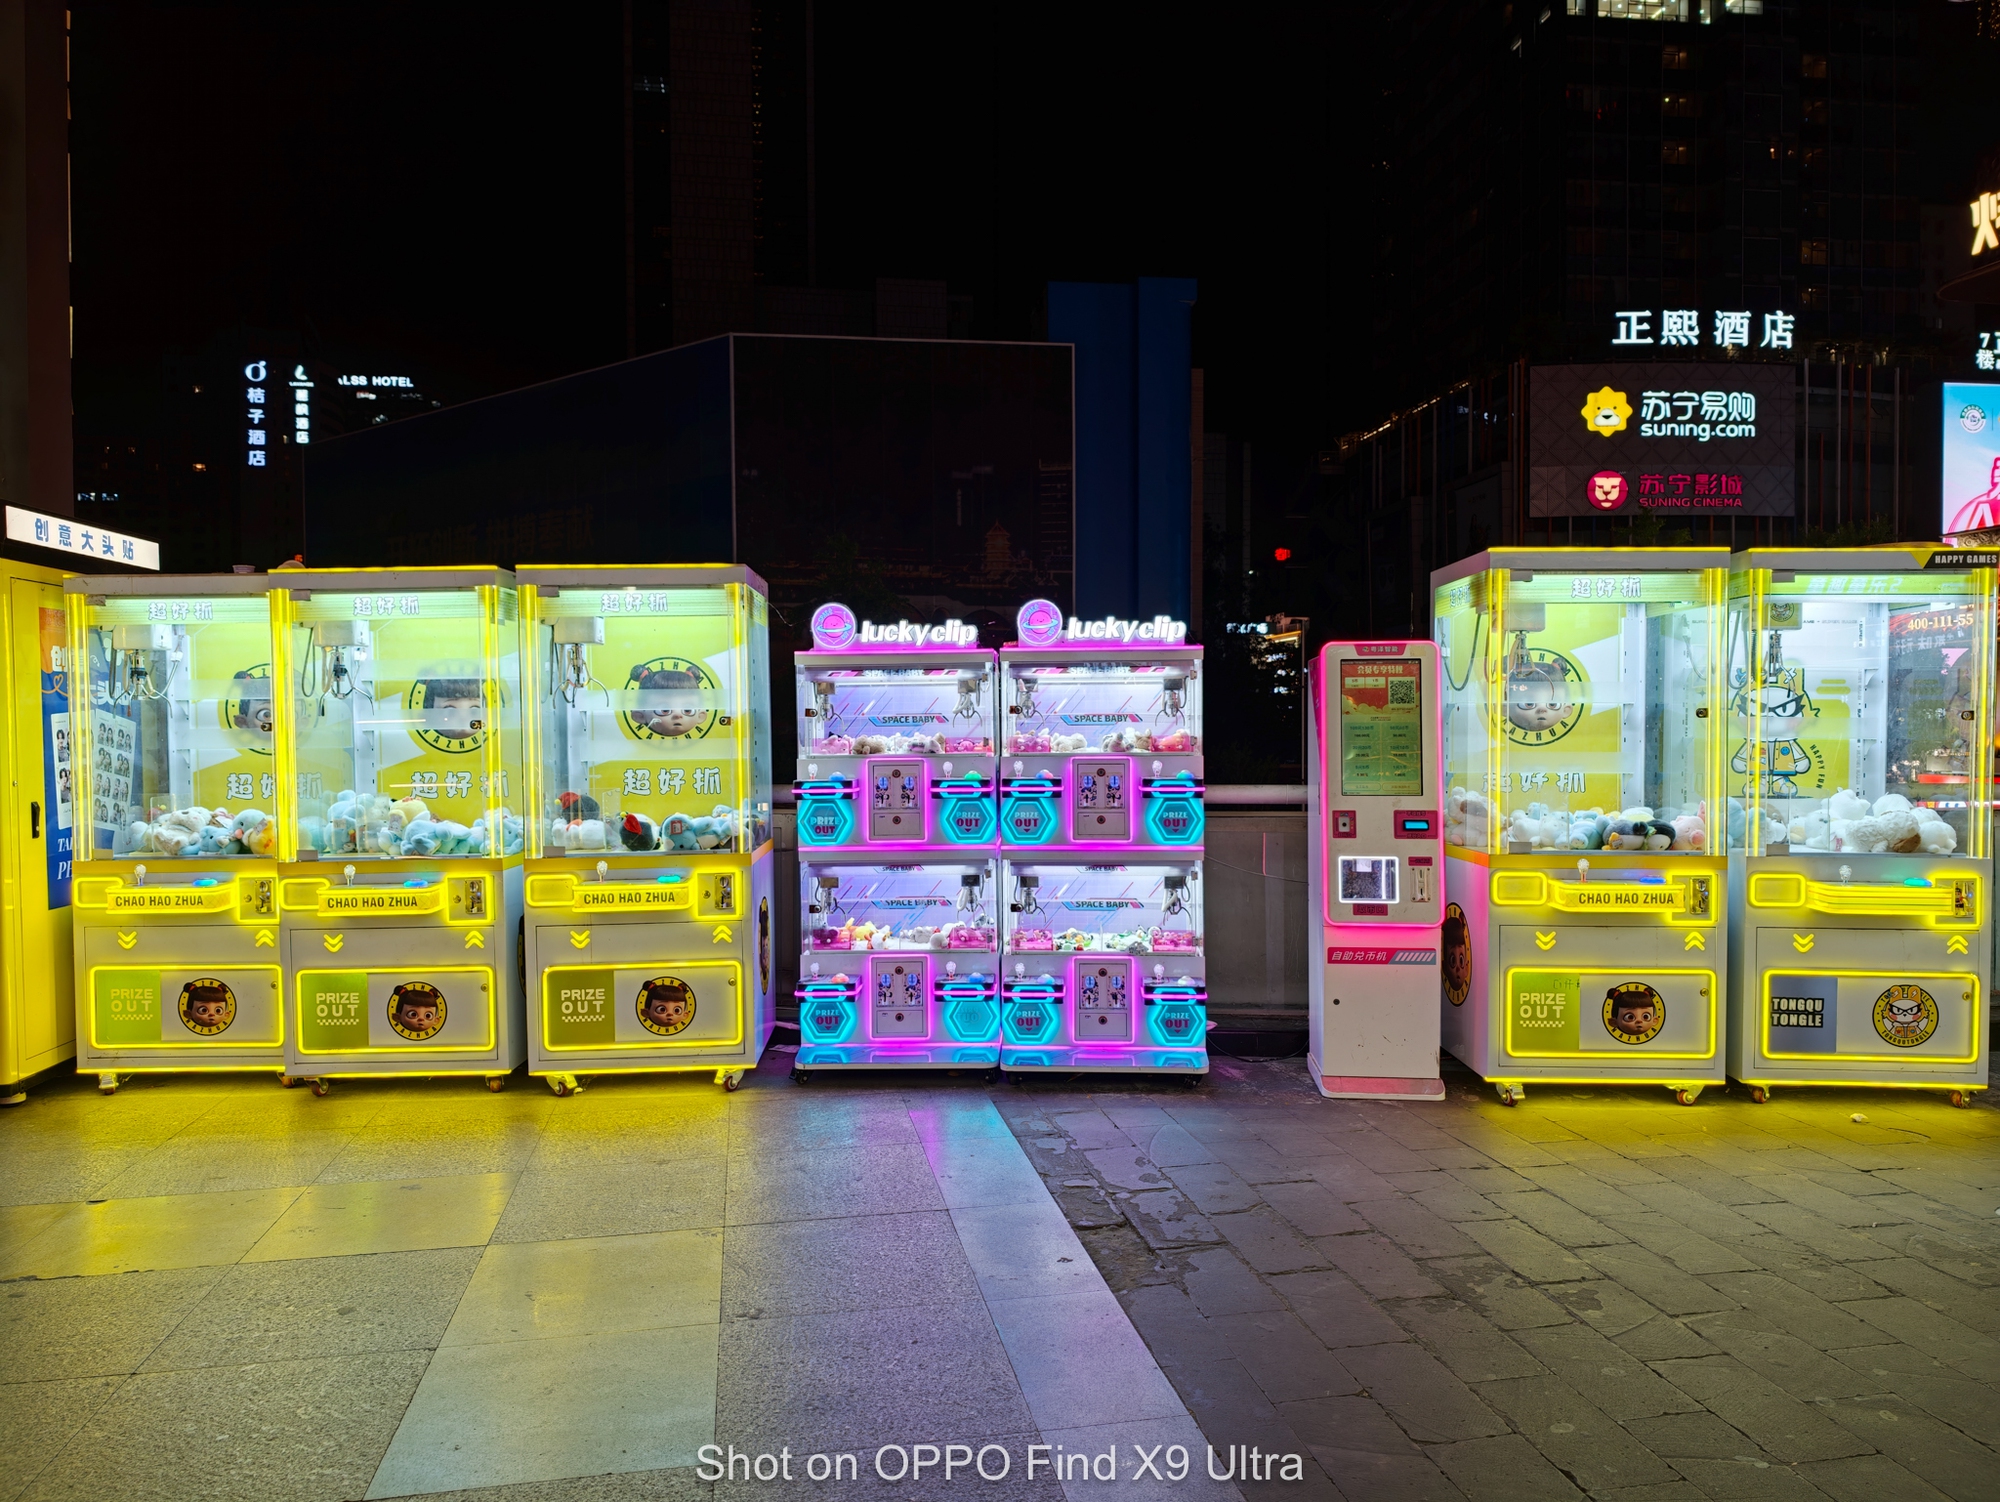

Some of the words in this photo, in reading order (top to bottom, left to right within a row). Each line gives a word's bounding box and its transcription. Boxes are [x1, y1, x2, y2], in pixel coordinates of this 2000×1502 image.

[1612, 310, 1795, 349] 正熙酒店
[338, 375, 368, 386] LSS
[372, 376, 414, 387] HOTEL
[1641, 391, 1756, 422] 苏宁易购
[247, 387, 266, 466] 桔子酒店
[1641, 423, 1755, 441] suning.com
[1639, 474, 1742, 495] 苏宁影城
[1640, 498, 1690, 507] SUNING
[1693, 498, 1743, 507] CINEMA
[35, 518, 134, 561] 创意大头贴
[1935, 554, 1964, 565] HAPPY
[1967, 554, 1998, 565] GAMES
[1571, 577, 1641, 598] 超好抓
[353, 596, 419, 616] 超好抓
[601, 593, 668, 612] 超好抓
[148, 602, 213, 621] 超好抓
[861, 620, 930, 645] lucky
[931, 619, 978, 645] clip
[1067, 616, 1139, 642] lucky
[1138, 615, 1187, 642] clip
[882, 716, 910, 724] SPACE
[912, 716, 935, 724] BABY
[1074, 715, 1103, 723] SPACE
[1105, 715, 1129, 723] BABY
[1810, 744, 1825, 770] HAPPY
[623, 767, 721, 796] 超好抓
[1817, 773, 1826, 789] FUN
[956, 818, 981, 827] OUT
[1015, 818, 1040, 827] OUT
[1163, 818, 1189, 827] OUT
[814, 826, 836, 834] OUT
[115, 895, 146, 907] CHAO
[149, 895, 171, 907] HAO
[175, 895, 204, 906] ZHUA
[327, 897, 358, 909] CHAO
[362, 897, 385, 908] HAO
[389, 896, 418, 907] ZHUA
[584, 893, 615, 905] CHAO
[619, 892, 642, 904] HAO
[645, 891, 675, 903] ZHUA
[885, 899, 913, 907] SPACE
[1578, 893, 1611, 905] CHAO
[1615, 893, 1639, 904] HAO
[1643, 893, 1675, 904] ZHUA
[1331, 951, 1387, 961] 自助兑币机
[110, 988, 153, 1000] PRIZE
[316, 993, 360, 1004] PRIZE
[561, 989, 605, 1000] PRIZE
[1520, 993, 1566, 1005] PRIZE
[111, 1000, 152, 1012] OUT
[317, 1004, 358, 1017] OUT
[561, 1001, 604, 1014] OUT
[1772, 998, 1824, 1012] TONGQU
[1520, 1006, 1564, 1018] OUT
[816, 1016, 840, 1025] OUT
[1017, 1018, 1040, 1026] OUT
[1165, 1020, 1190, 1028] OUT
[1772, 1013, 1823, 1027] TONGLE
